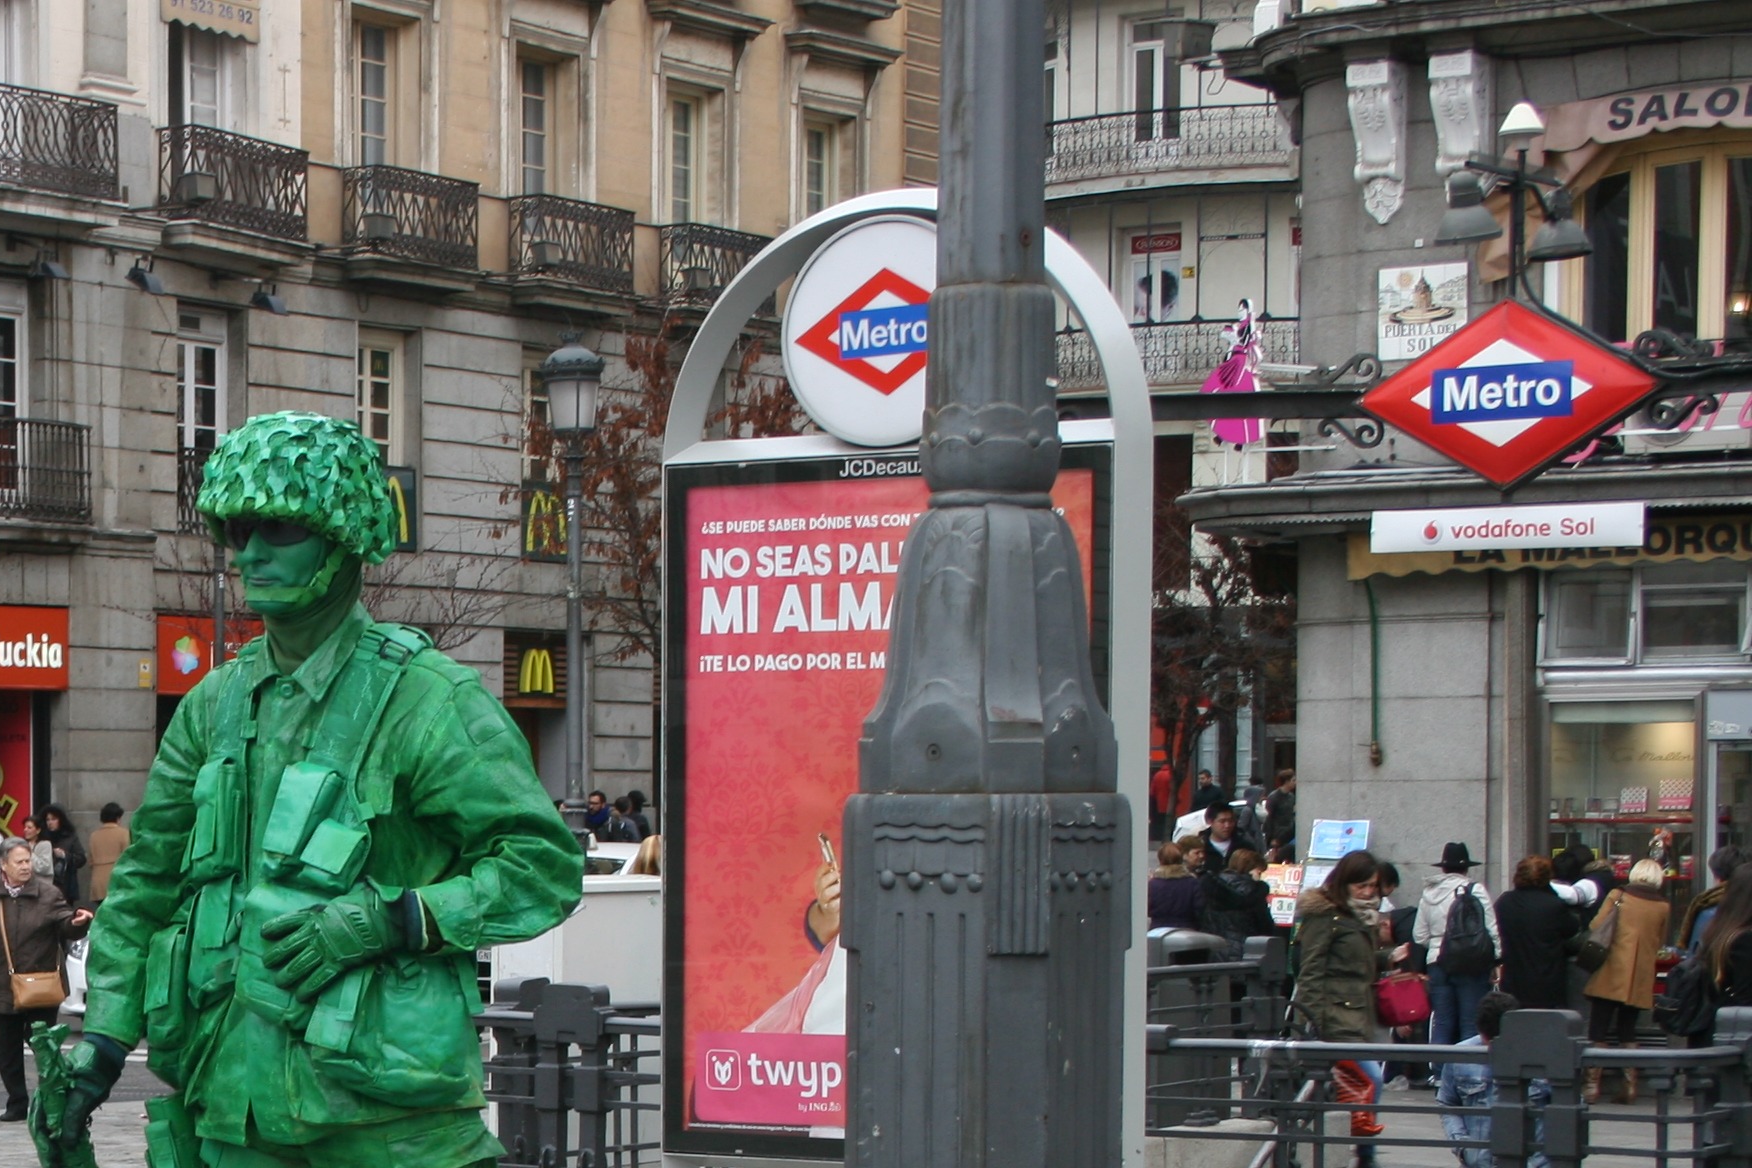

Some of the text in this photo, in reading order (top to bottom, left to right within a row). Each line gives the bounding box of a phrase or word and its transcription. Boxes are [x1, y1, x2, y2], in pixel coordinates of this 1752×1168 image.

[191, 0, 214, 15] 523
[219, 4, 233, 19] 26
[238, 8, 253, 24] 92
[841, 317, 928, 352] Metro
[1385, 324, 1436, 338] PUERTA
[1442, 374, 1561, 413] Metro
[701, 521, 723, 534] ¿SE
[726, 519, 765, 533] PUEDE
[768, 517, 805, 531] SABER
[809, 513, 851, 530] DÓNDE
[853, 514, 878, 528] VAS
[881, 513, 910, 527] CON
[1451, 517, 1594, 540] vodafone Sol
[700, 547, 750, 579] NO
[756, 544, 832, 577] SEAS
[700, 585, 759, 635] MI
[700, 652, 887, 673] ¡TE LO PAGO POR EL M
[1288, 869, 1300, 882] 10
[747, 1052, 842, 1098] twyp
[798, 1103, 827, 1112] by ING
